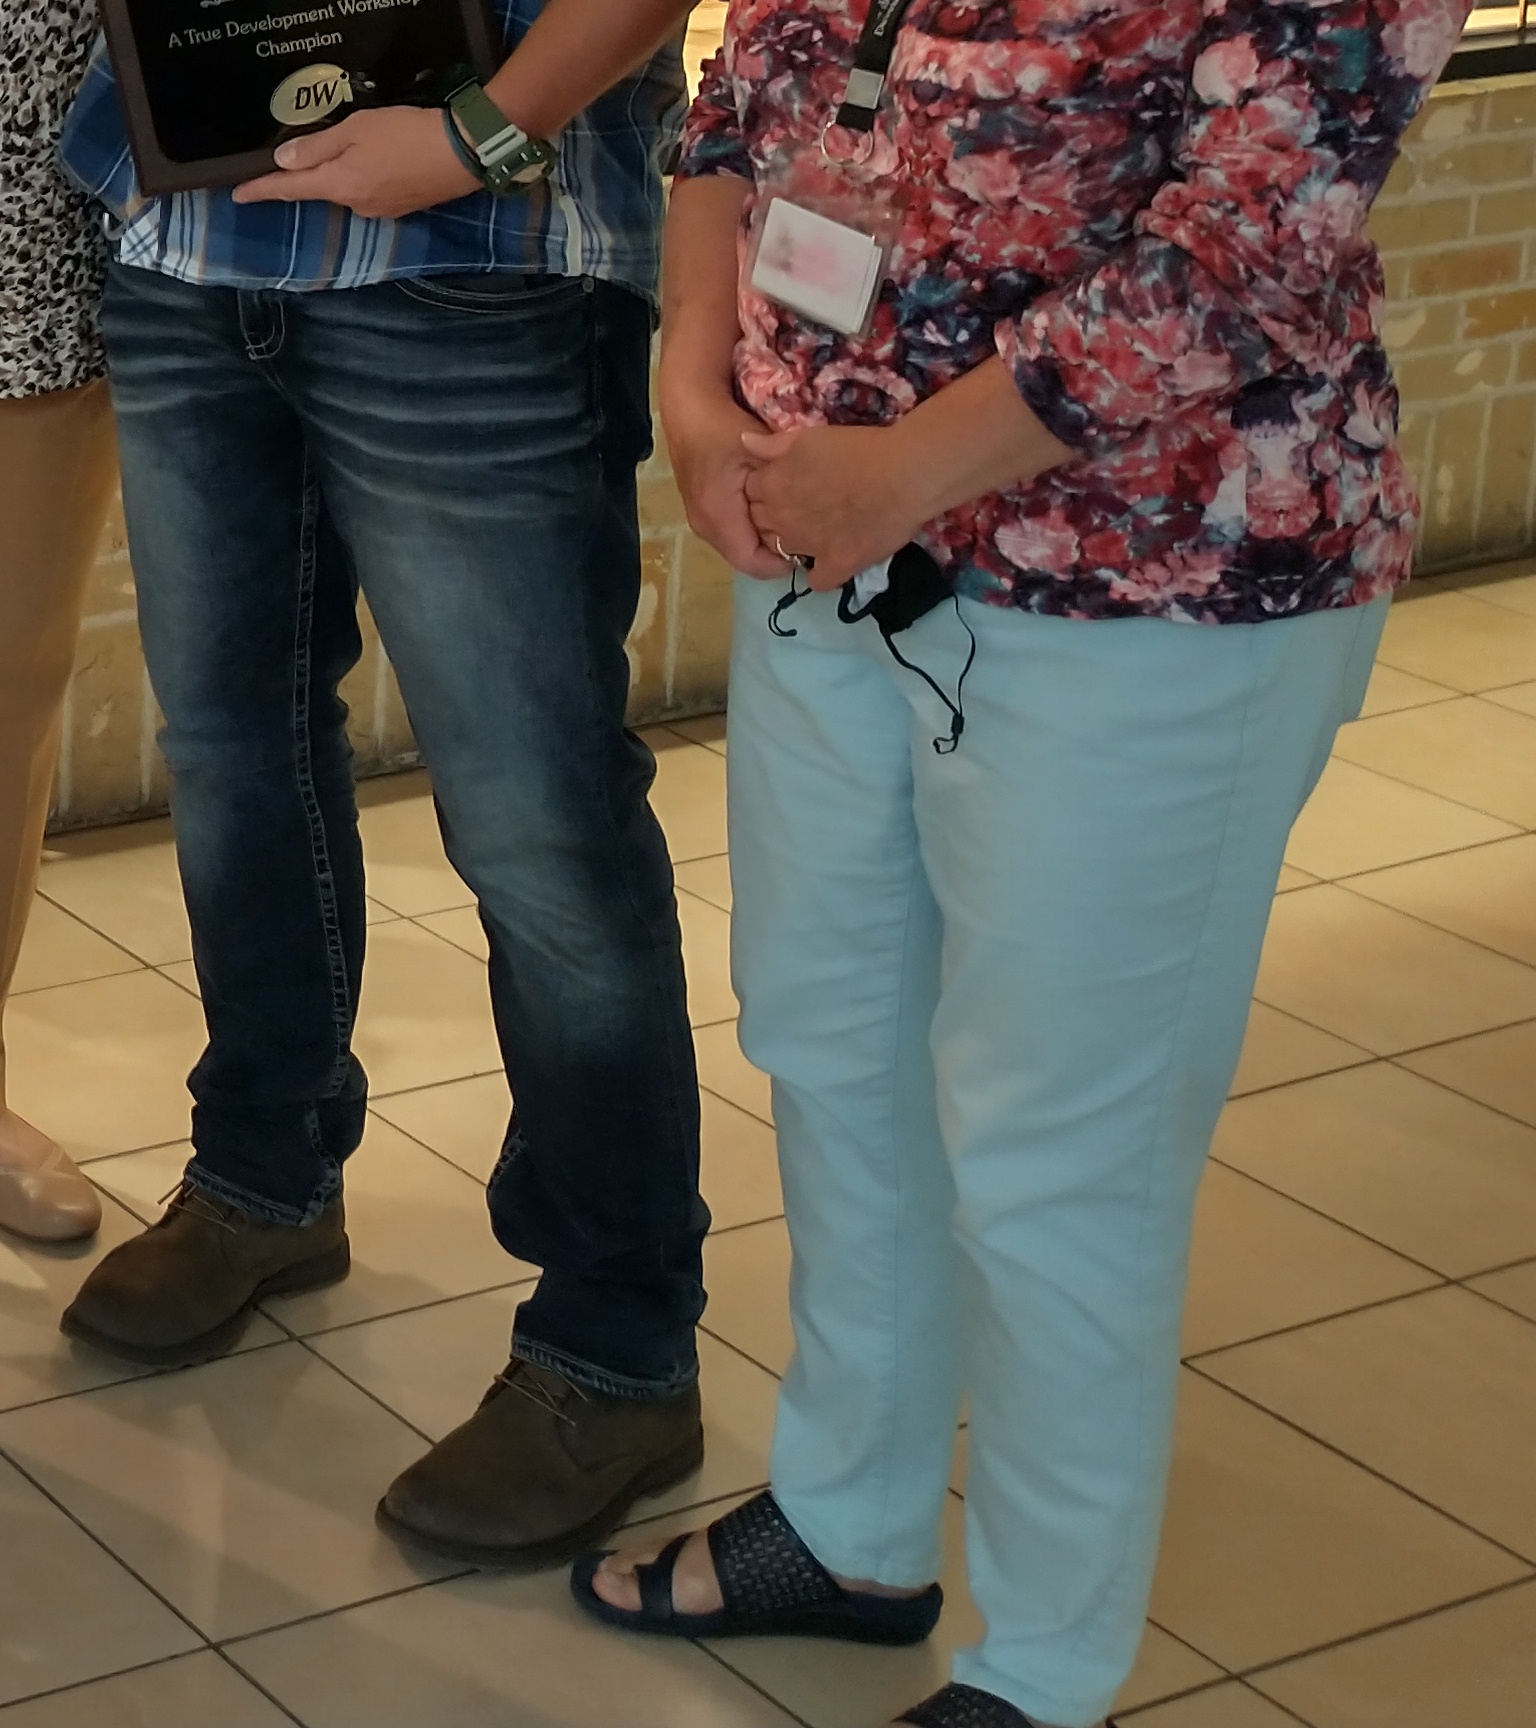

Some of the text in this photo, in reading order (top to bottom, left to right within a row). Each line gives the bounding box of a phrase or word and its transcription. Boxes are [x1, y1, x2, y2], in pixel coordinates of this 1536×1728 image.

[168, 32, 183, 49] A
[184, 28, 222, 45] True
[225, 4, 336, 39] Development
[256, 30, 343, 58] Champion
[295, 78, 340, 111] DW
